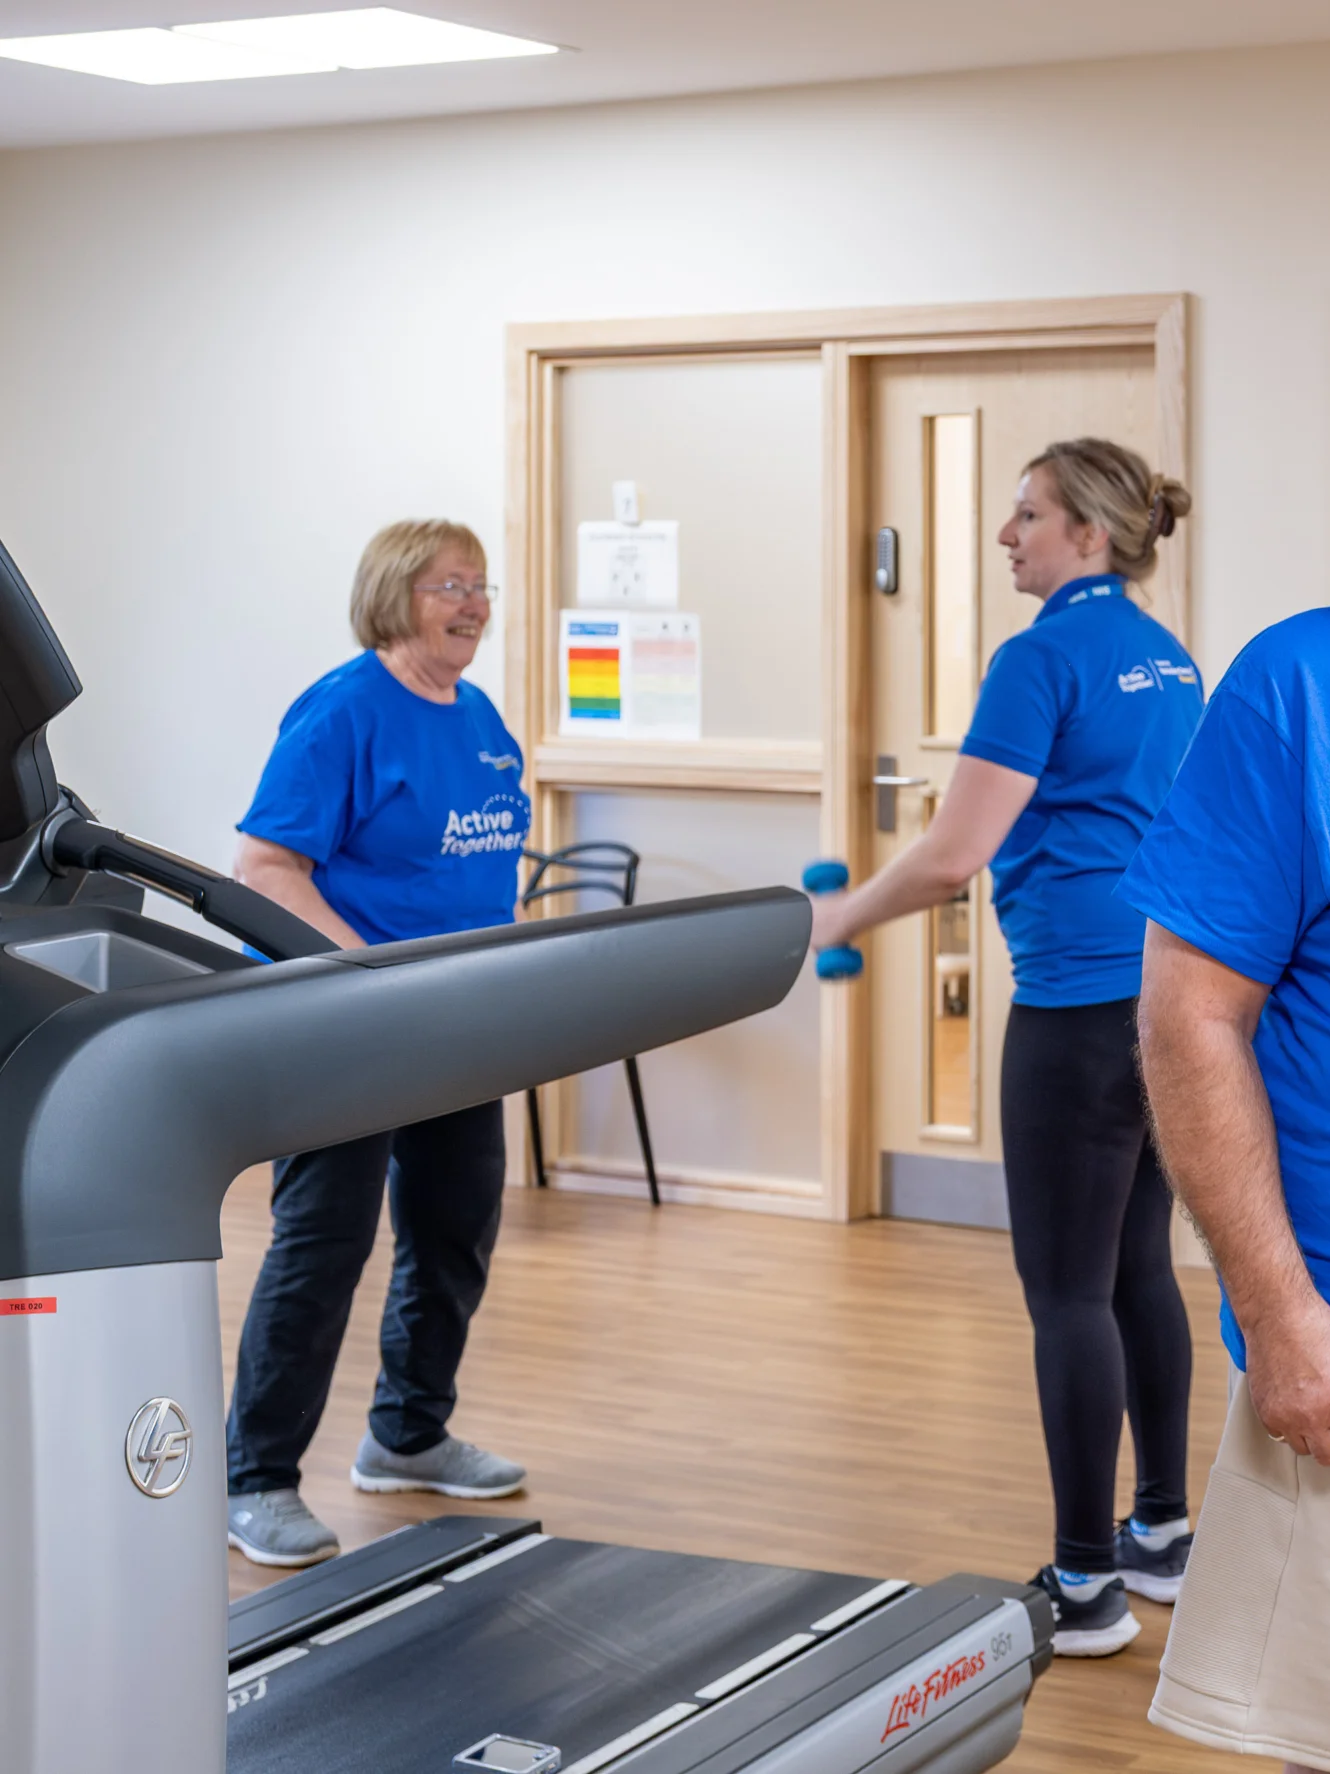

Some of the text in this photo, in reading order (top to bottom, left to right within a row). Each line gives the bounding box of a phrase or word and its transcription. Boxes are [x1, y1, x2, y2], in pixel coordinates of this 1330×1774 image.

[443, 809, 514, 836] Active
[9, 1302, 43, 1311] TRE 020
[880, 1684, 921, 1744] Life
[921, 1649, 986, 1719] Fitness
